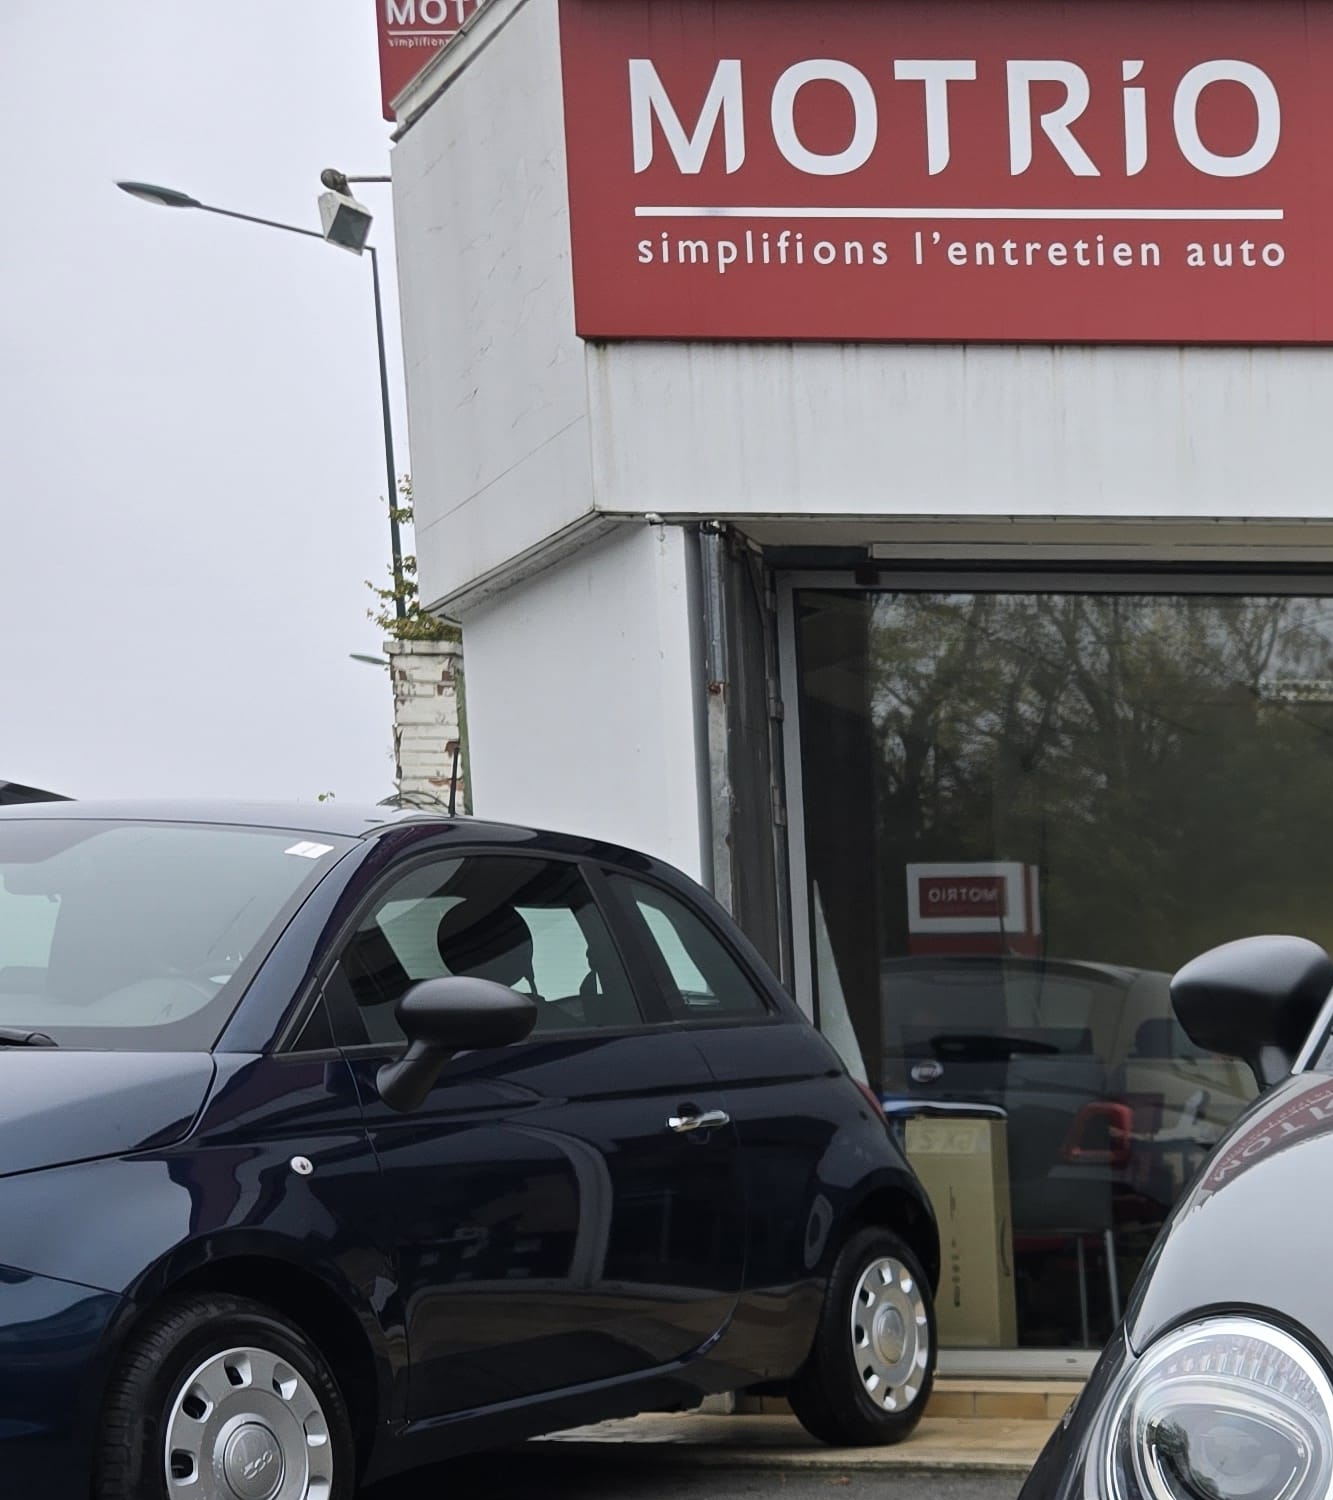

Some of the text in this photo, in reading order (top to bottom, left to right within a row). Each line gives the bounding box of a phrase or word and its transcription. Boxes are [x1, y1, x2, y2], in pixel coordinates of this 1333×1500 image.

[386, 0, 481, 25] MOT
[637, 229, 1286, 274] simplifions l'entretien auto
